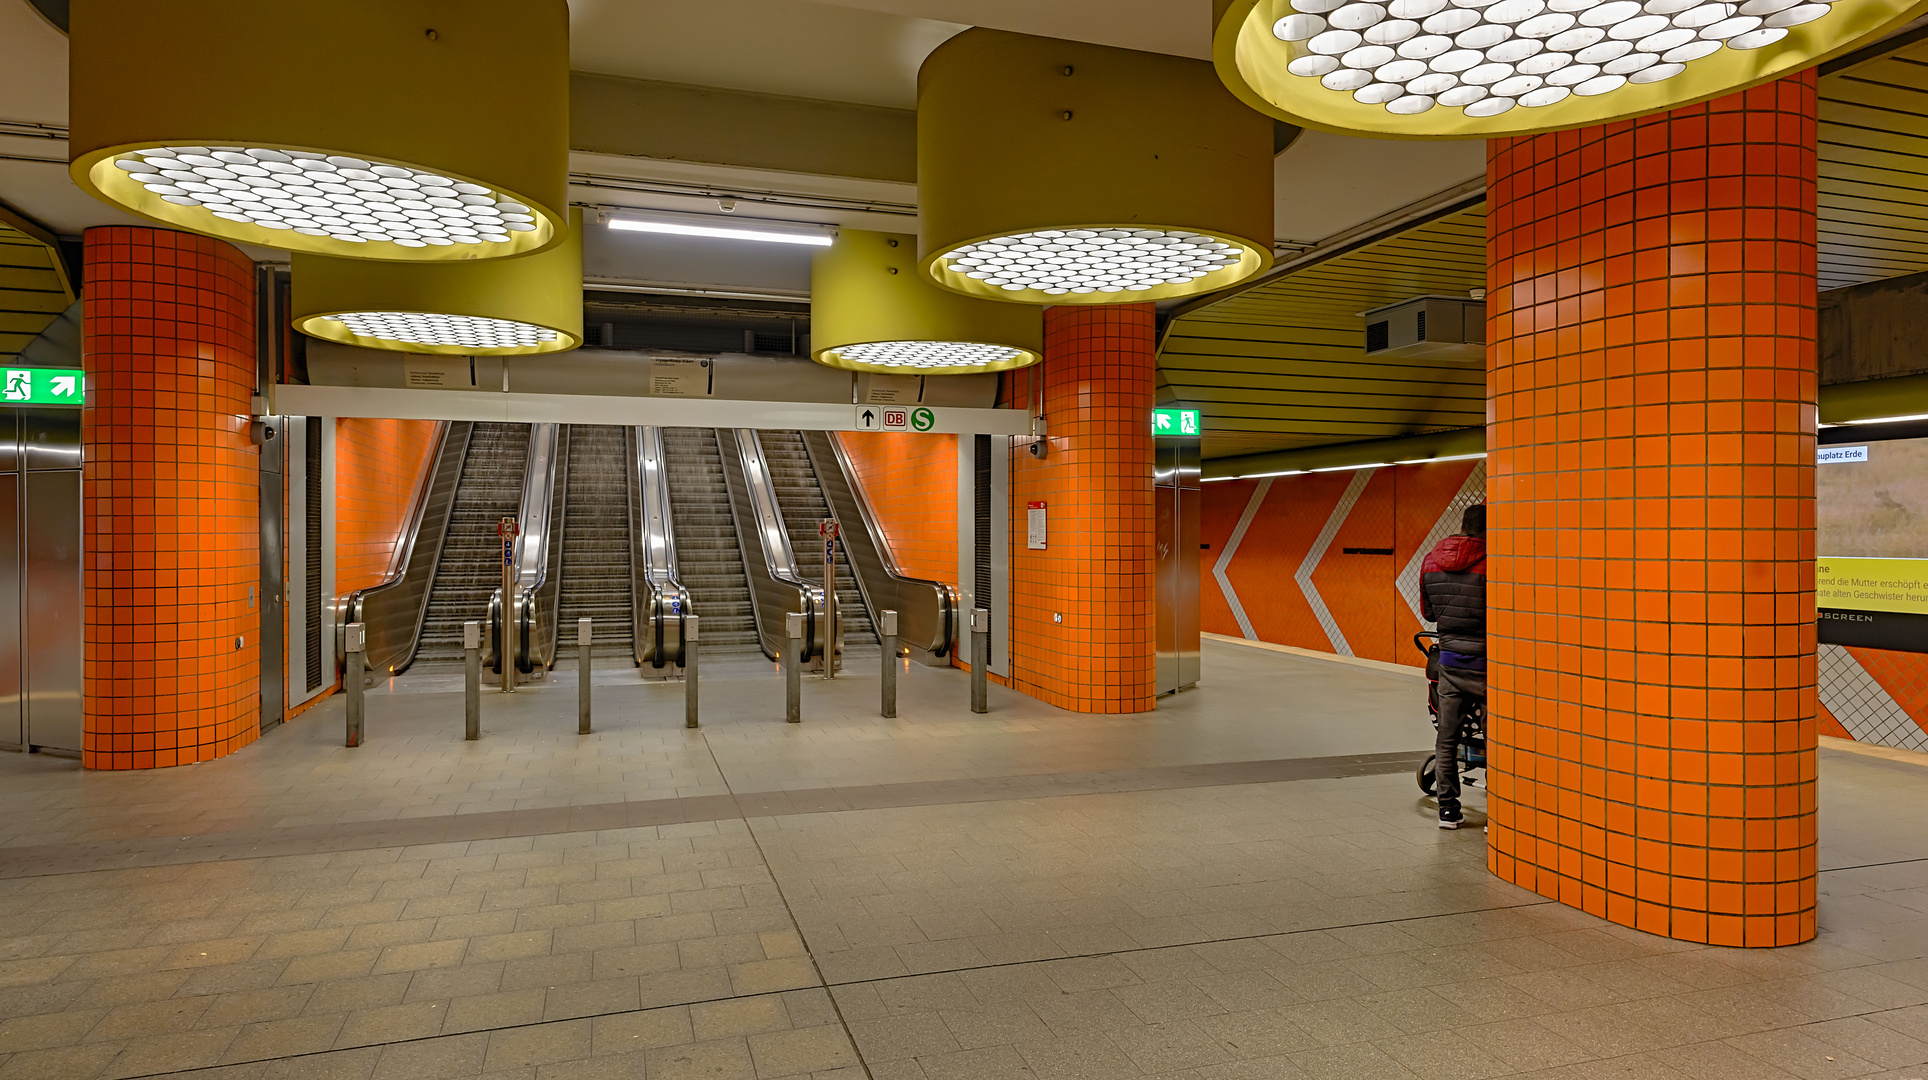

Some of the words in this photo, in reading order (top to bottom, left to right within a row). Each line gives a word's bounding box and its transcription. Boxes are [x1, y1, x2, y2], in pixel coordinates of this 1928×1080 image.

[886, 413, 904, 424] DB
[914, 409, 931, 430] S
[1844, 450, 1862, 458] Erde
[1837, 578, 1849, 586] die
[1851, 578, 1878, 588] Mutter
[1880, 580, 1921, 590] erschöpft
[1832, 589, 1852, 598] alten
[1853, 590, 1904, 601] Geschwister
[1824, 612, 1873, 622] SCREEN
